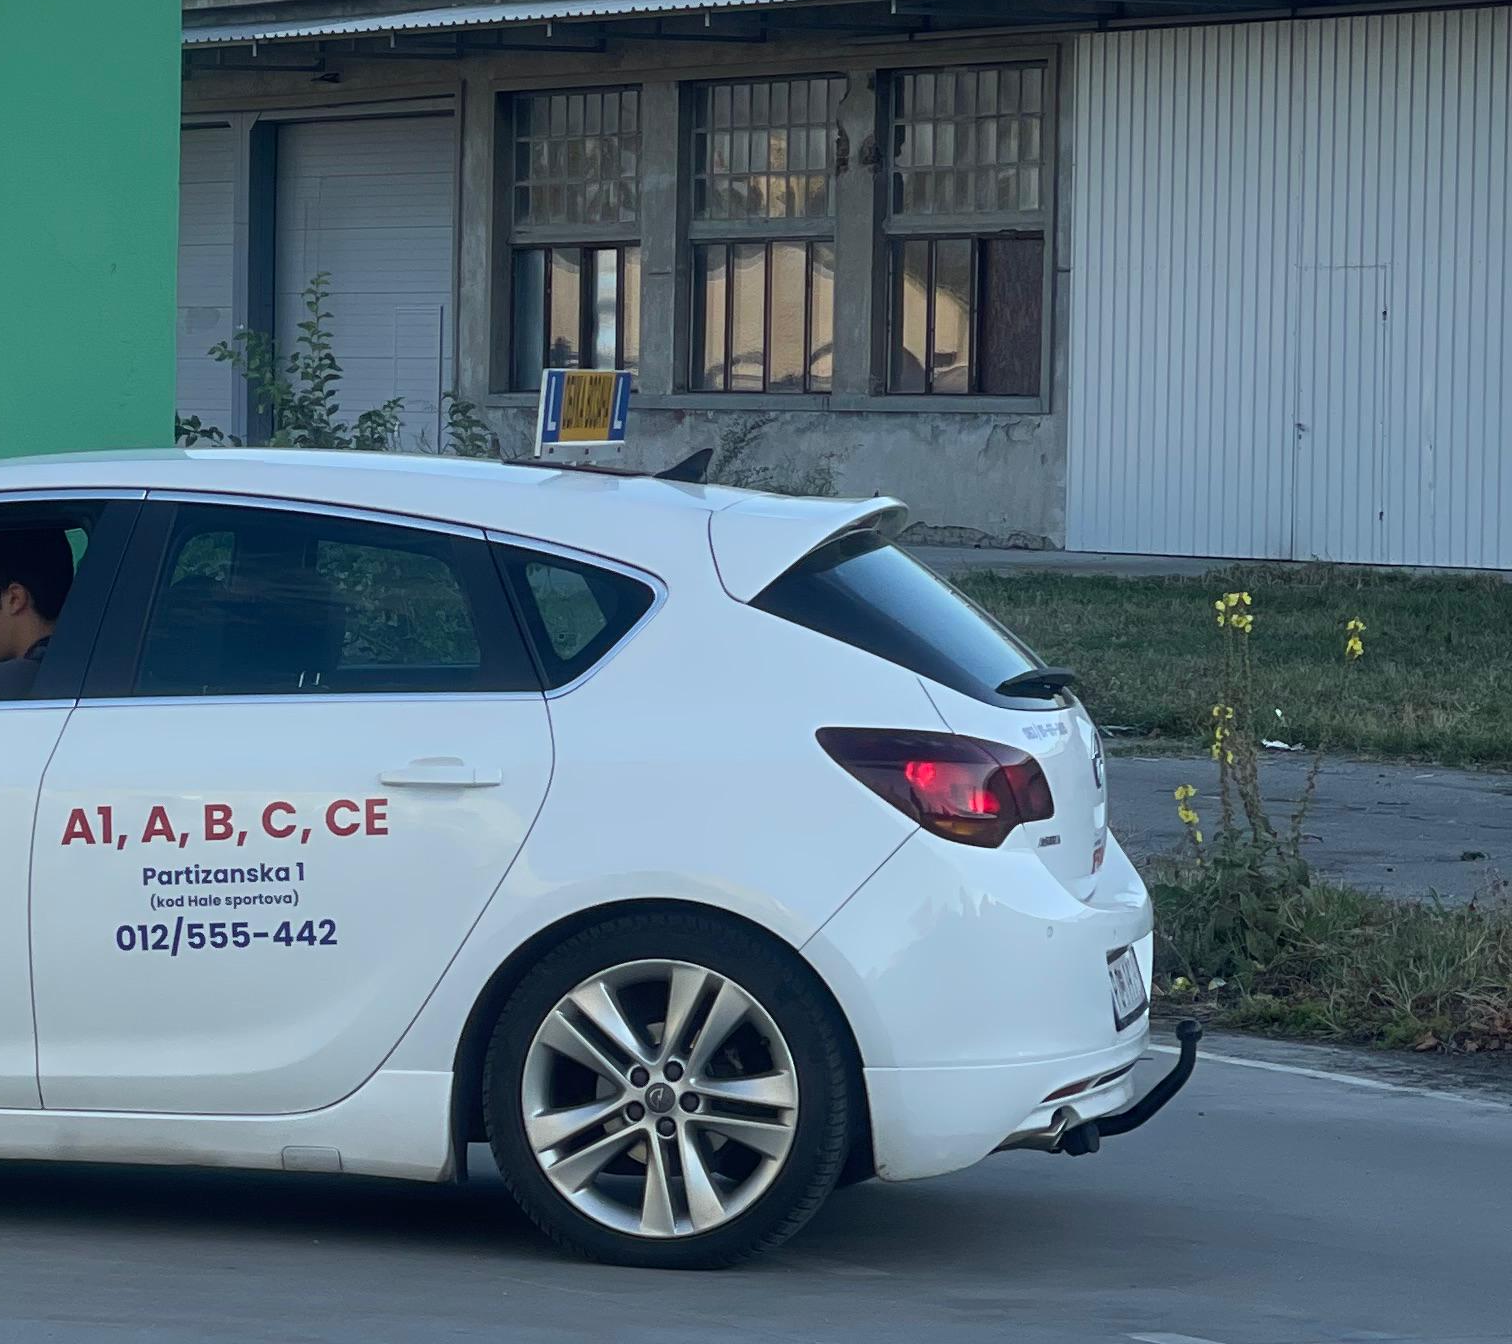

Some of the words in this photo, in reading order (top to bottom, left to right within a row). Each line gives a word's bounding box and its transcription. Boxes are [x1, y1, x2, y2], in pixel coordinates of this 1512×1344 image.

[61, 805, 128, 850] A1,
[141, 805, 190, 848] A,
[204, 803, 248, 847] B,
[261, 801, 312, 844] C,
[325, 798, 389, 836] CE
[142, 863, 289, 886] Partizanska
[296, 862, 305, 881] 1
[150, 892, 184, 910] (kod
[188, 894, 221, 907] Hale
[225, 889, 299, 909] sportova)
[116, 916, 338, 956] 012/555-442
